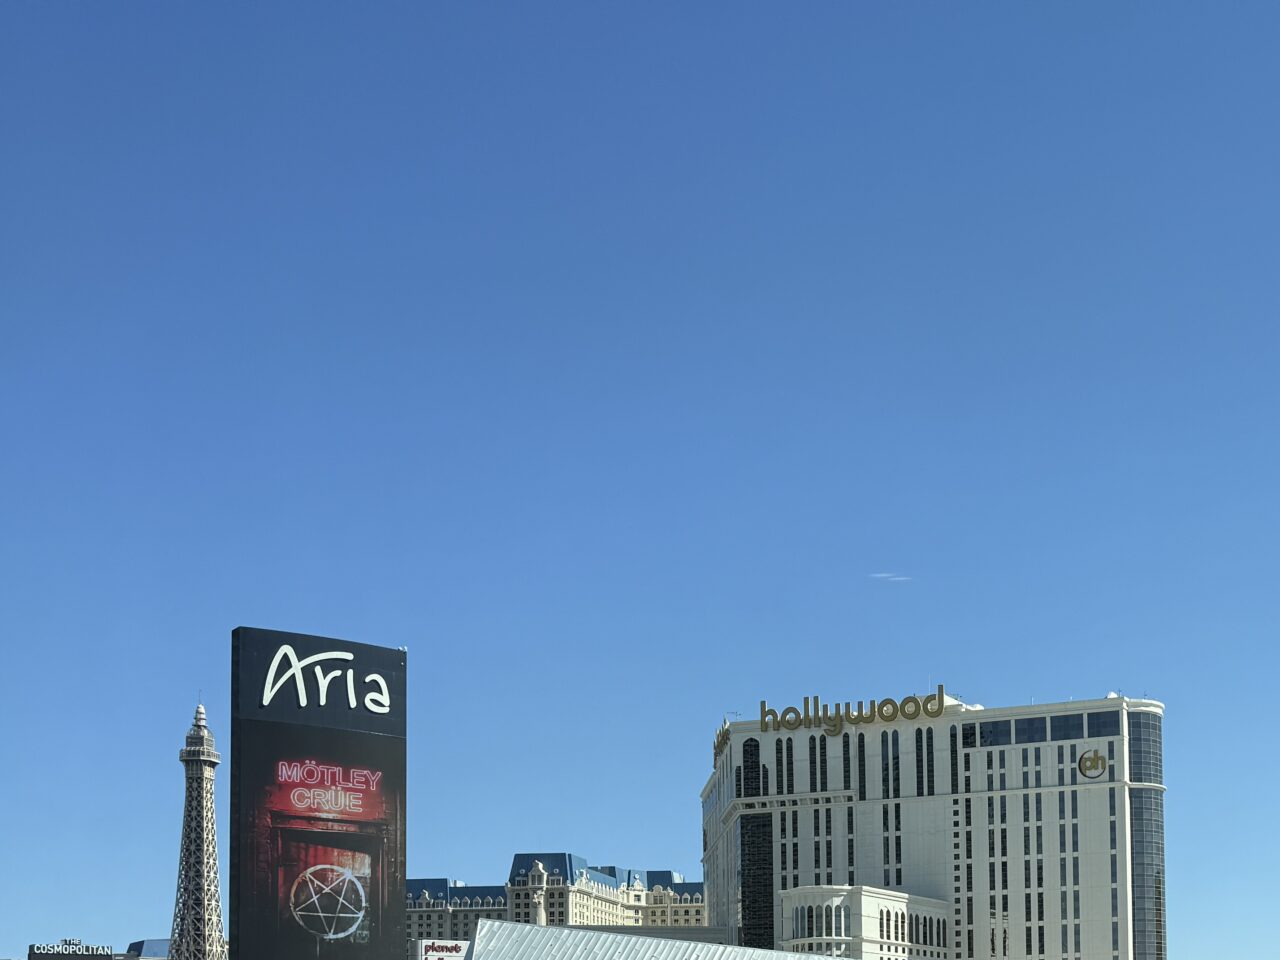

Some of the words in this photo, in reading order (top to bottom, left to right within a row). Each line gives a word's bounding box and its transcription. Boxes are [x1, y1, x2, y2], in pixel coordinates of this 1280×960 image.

[262, 644, 391, 714] Aria
[760, 684, 944, 736] hollywood
[278, 759, 382, 791] MÖTLEY
[290, 786, 363, 812] CRÜE
[34, 944, 112, 955] COSMOPOLITAN
[424, 941, 462, 955] planet
